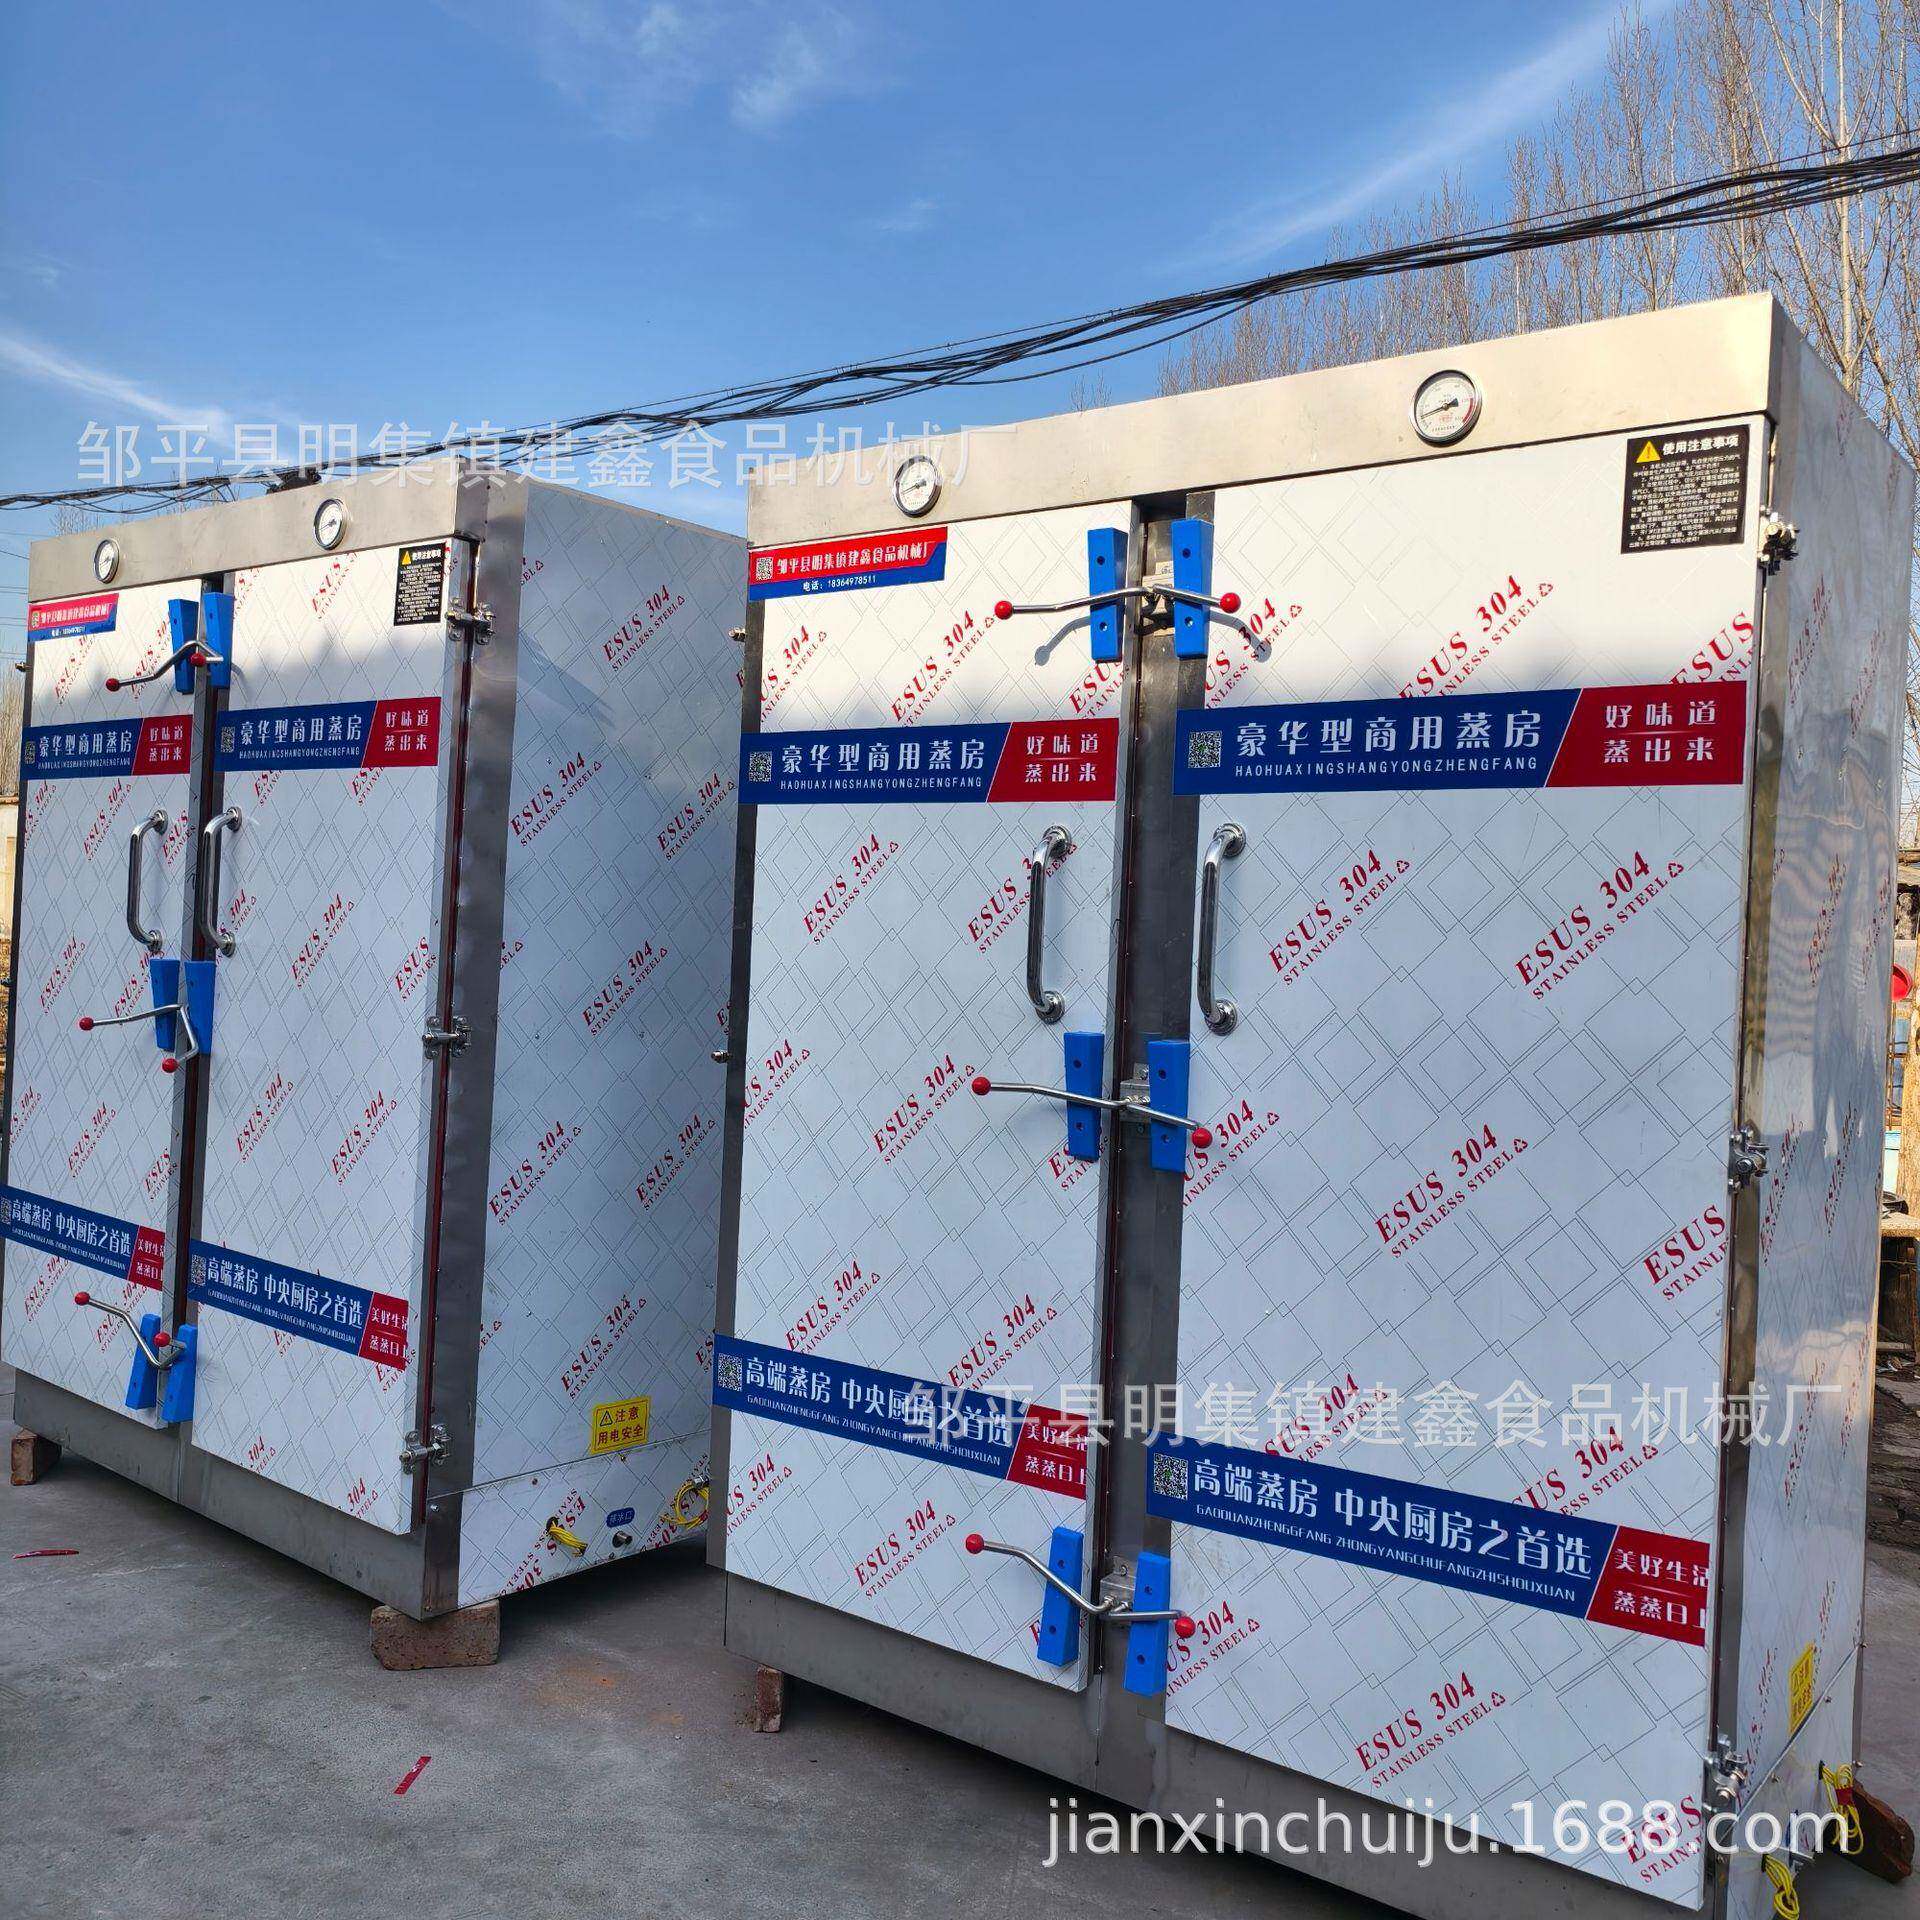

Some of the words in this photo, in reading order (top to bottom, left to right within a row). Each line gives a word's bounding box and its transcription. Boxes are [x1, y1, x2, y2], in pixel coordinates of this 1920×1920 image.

[1663, 434, 1739, 455] 使用注意事项
[777, 542, 935, 574] 邹平县明集镇建鑫食品机械厂
[602, 613, 643, 662] ESUS
[646, 584, 670, 618] 304
[611, 628, 654, 672] STAINLESS
[654, 602, 678, 628] STEEL
[1239, 598, 1277, 651] 304
[1476, 575, 1523, 634] 304
[1491, 596, 1539, 648] STEEL
[783, 625, 810, 667] 304
[891, 656, 938, 722] ESUS
[943, 610, 975, 656] 304
[954, 630, 985, 667] STEEL
[1251, 619, 1290, 661] STEEL
[39, 730, 132, 757] 豪华型商用蒸房
[240, 714, 362, 745] 豪华型商用蒸房
[385, 734, 427, 751] 蒸出来
[386, 710, 429, 727] 好味道
[1026, 732, 1100, 755] 好味道
[1237, 709, 1541, 758] 豪华型商用蒸房
[1604, 700, 1716, 729] 好味道
[781, 777, 982, 790] HAOHUAXINGSHANGYONGZHENGFANG
[782, 739, 984, 773] 豪华型商用蒸房
[1025, 763, 1098, 784] 蒸出来
[1235, 757, 1538, 777] HAOHUAXINGSHANGYONGZHENGFANG
[1604, 736, 1714, 764] 蒸出来
[510, 784, 554, 838] ESUS
[558, 752, 586, 788] 304
[520, 796, 567, 847] STAINLESS
[567, 770, 594, 798] STEEL
[656, 802, 694, 851] ESUS
[697, 772, 722, 807] 304
[666, 817, 706, 861] STAINLESS
[705, 789, 730, 818] STEEL
[803, 875, 848, 935] ESUS
[851, 834, 881, 877] 304
[813, 888, 860, 945] STAINLESS
[861, 853, 890, 888] STEEL
[967, 877, 1017, 943] ESUS
[1269, 899, 1332, 973] ESUS
[1339, 850, 1381, 902] 304
[1515, 905, 1591, 986] ESUS
[1599, 850, 1652, 909] 304
[291, 928, 321, 980] ESUS
[323, 893, 342, 931] 304
[395, 936, 429, 991] ESUS
[1283, 914, 1352, 986] STAINLESS
[1353, 873, 1396, 915] STEEL
[1531, 923, 1616, 1001] STAINLESS
[1616, 873, 1668, 925] STEEL
[582, 973, 624, 1027] ESUS
[627, 940, 653, 976] 304
[590, 986, 635, 1037] STAINLESS
[635, 956, 662, 985] STEEL
[765, 1038, 793, 1080] 304
[332, 1122, 361, 1175] ESUS
[364, 1089, 384, 1127] 304
[872, 1094, 920, 1154] ESUS
[923, 1054, 955, 1098] 304
[883, 1109, 934, 1165] STAINLESS
[935, 1074, 966, 1111] STEEL
[1215, 1099, 1254, 1148] 304
[488, 1158, 534, 1217] ESUS
[537, 1120, 565, 1160] 304
[636, 1149, 674, 1203] ESUS
[677, 1114, 701, 1150] 304
[643, 1159, 685, 1211] STAINLESS
[685, 1128, 709, 1159] STEEL
[1228, 1124, 1268, 1161] STEEL
[498, 1169, 546, 1226] STAINLESS
[546, 1137, 574, 1168] STEEL
[1374, 1170, 1445, 1244] ESUS
[1450, 1123, 1499, 1179] 304
[1391, 1188, 1469, 1259] STAINLESS
[1470, 1148, 1514, 1195] STEEL
[1643, 1204, 1726, 1286] ESUS
[208, 1257, 259, 1295] 高端蒸房
[265, 1274, 364, 1329] 中央厨房之首选
[786, 1296, 829, 1353] ESUS
[833, 1259, 862, 1302] 304
[842, 1279, 872, 1312] STEEL
[561, 1334, 602, 1392] ESUS
[605, 1294, 632, 1332] 304
[569, 1342, 614, 1400] STAINLESS
[613, 1308, 639, 1342] STEEL
[948, 1330, 998, 1389] ESUS
[1003, 1294, 1036, 1338] 304
[1013, 1317, 1048, 1350] STEEL
[615, 1406, 639, 1423] 注意
[746, 1357, 831, 1404] 高端蒸房
[1317, 1373, 1361, 1423] 304
[598, 1425, 644, 1444] 用电安全
[1574, 1426, 1624, 1479] 304
[749, 1452, 775, 1492] 304
[1591, 1455, 1643, 1497] STEEL
[855, 1531, 901, 1589] ESUS
[904, 1497, 937, 1540] 304
[1194, 1459, 1318, 1518] 高端蒸房
[1335, 1488, 1592, 1580] 中央厨房之首选
[865, 1548, 914, 1601] STAINLESS
[916, 1522, 946, 1553] STEEL
[1196, 1600, 1235, 1646] 304
[1209, 1628, 1248, 1661] STEEL
[1356, 1708, 1423, 1772] ESUS
[1430, 1671, 1475, 1721] 304
[1373, 1734, 1444, 1789] STAINLESS
[1445, 1701, 1492, 1738] STEEL
